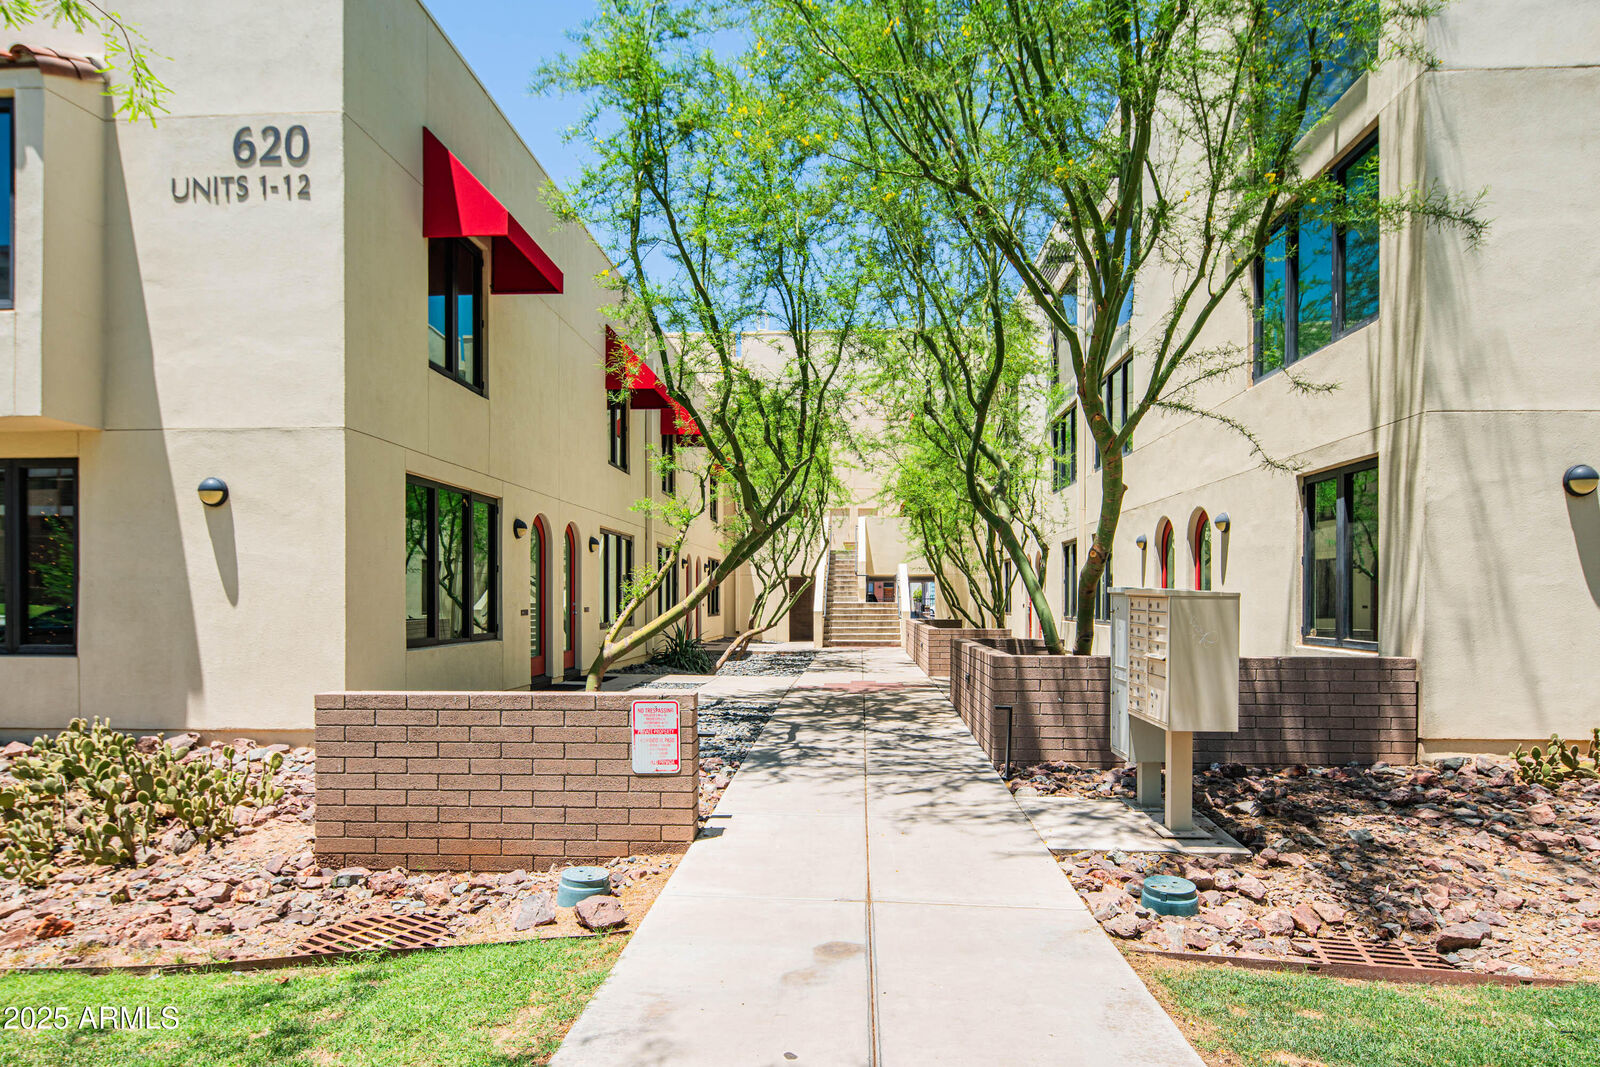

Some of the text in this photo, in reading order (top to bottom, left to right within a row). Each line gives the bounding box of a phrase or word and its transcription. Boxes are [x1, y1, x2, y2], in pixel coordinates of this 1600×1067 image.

[233, 125, 310, 168] 620
[171, 174, 311, 204] UNITS 1-12
